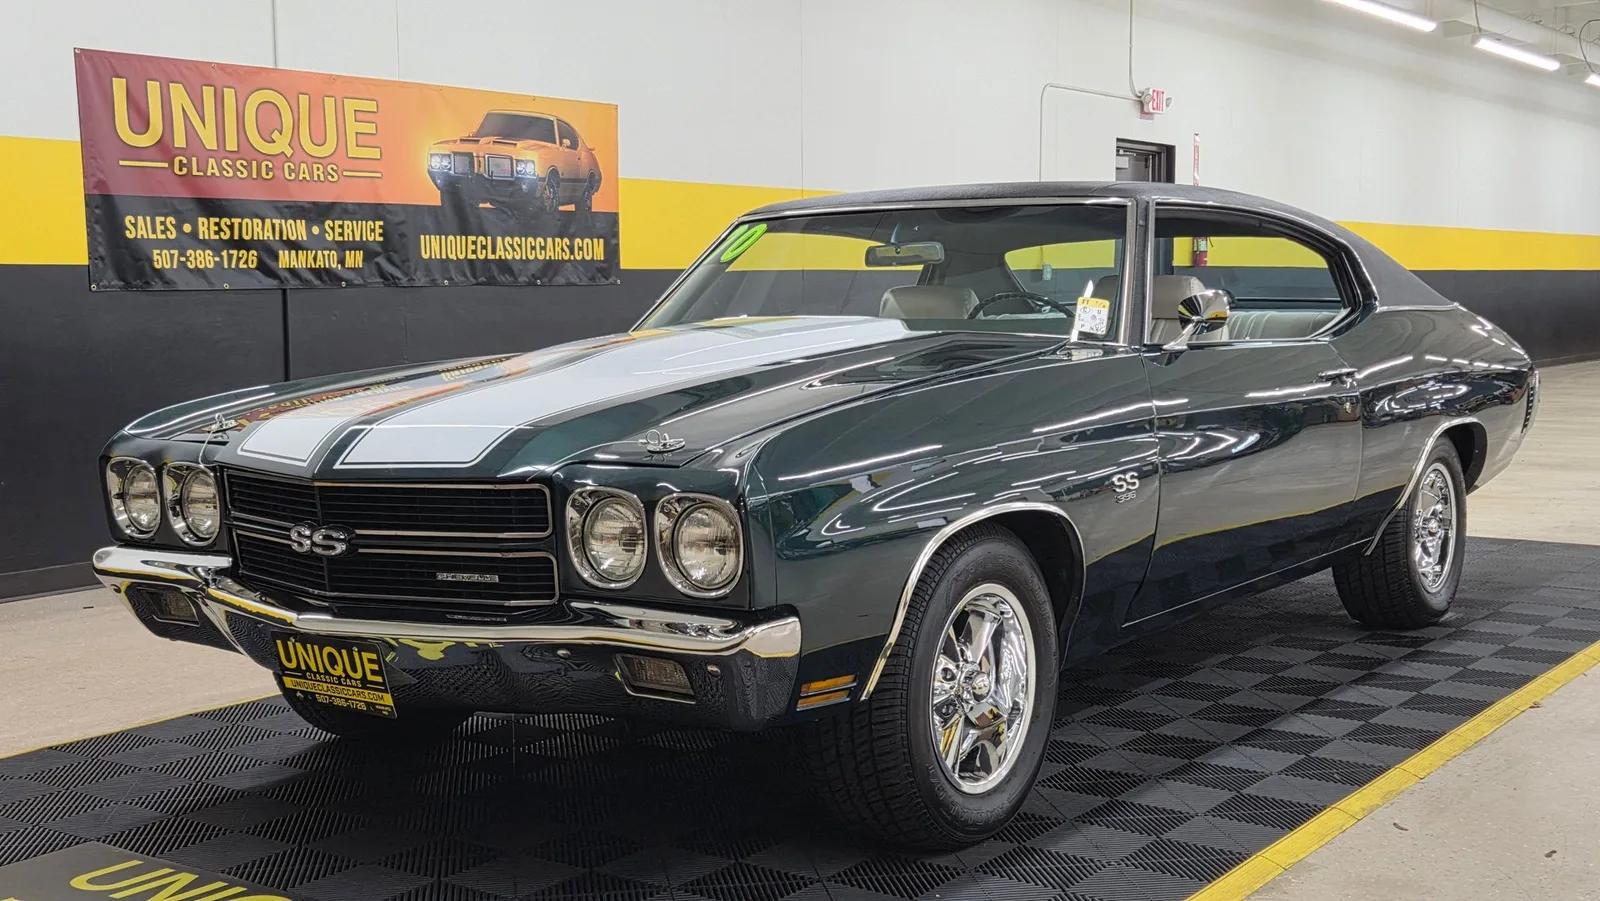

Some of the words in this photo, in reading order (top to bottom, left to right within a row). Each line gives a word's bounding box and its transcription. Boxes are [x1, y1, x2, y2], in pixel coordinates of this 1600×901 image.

[1152, 89, 1165, 112] EXIT
[112, 77, 381, 159] UNIQUE
[173, 156, 274, 180] CLASSIC
[283, 162, 340, 182] CARS
[124, 215, 177, 240] SALES
[198, 217, 307, 241] RESTORATION
[324, 220, 384, 242] SERVICE
[152, 249, 258, 269] 507-386-1726
[278, 249, 342, 271] MANKATO,
[345, 250, 363, 269] MN
[420, 234, 605, 261] UNIQUECLASSICCARS.COM
[1113, 472, 1139, 492] SS
[289, 524, 348, 556] SS
[276, 640, 383, 682] UNIQUE
[290, 679, 385, 703] UNIQUECLASSICCARS.COM
[305, 672, 339, 684] CLASSIC
[340, 677, 362, 688] CARS
